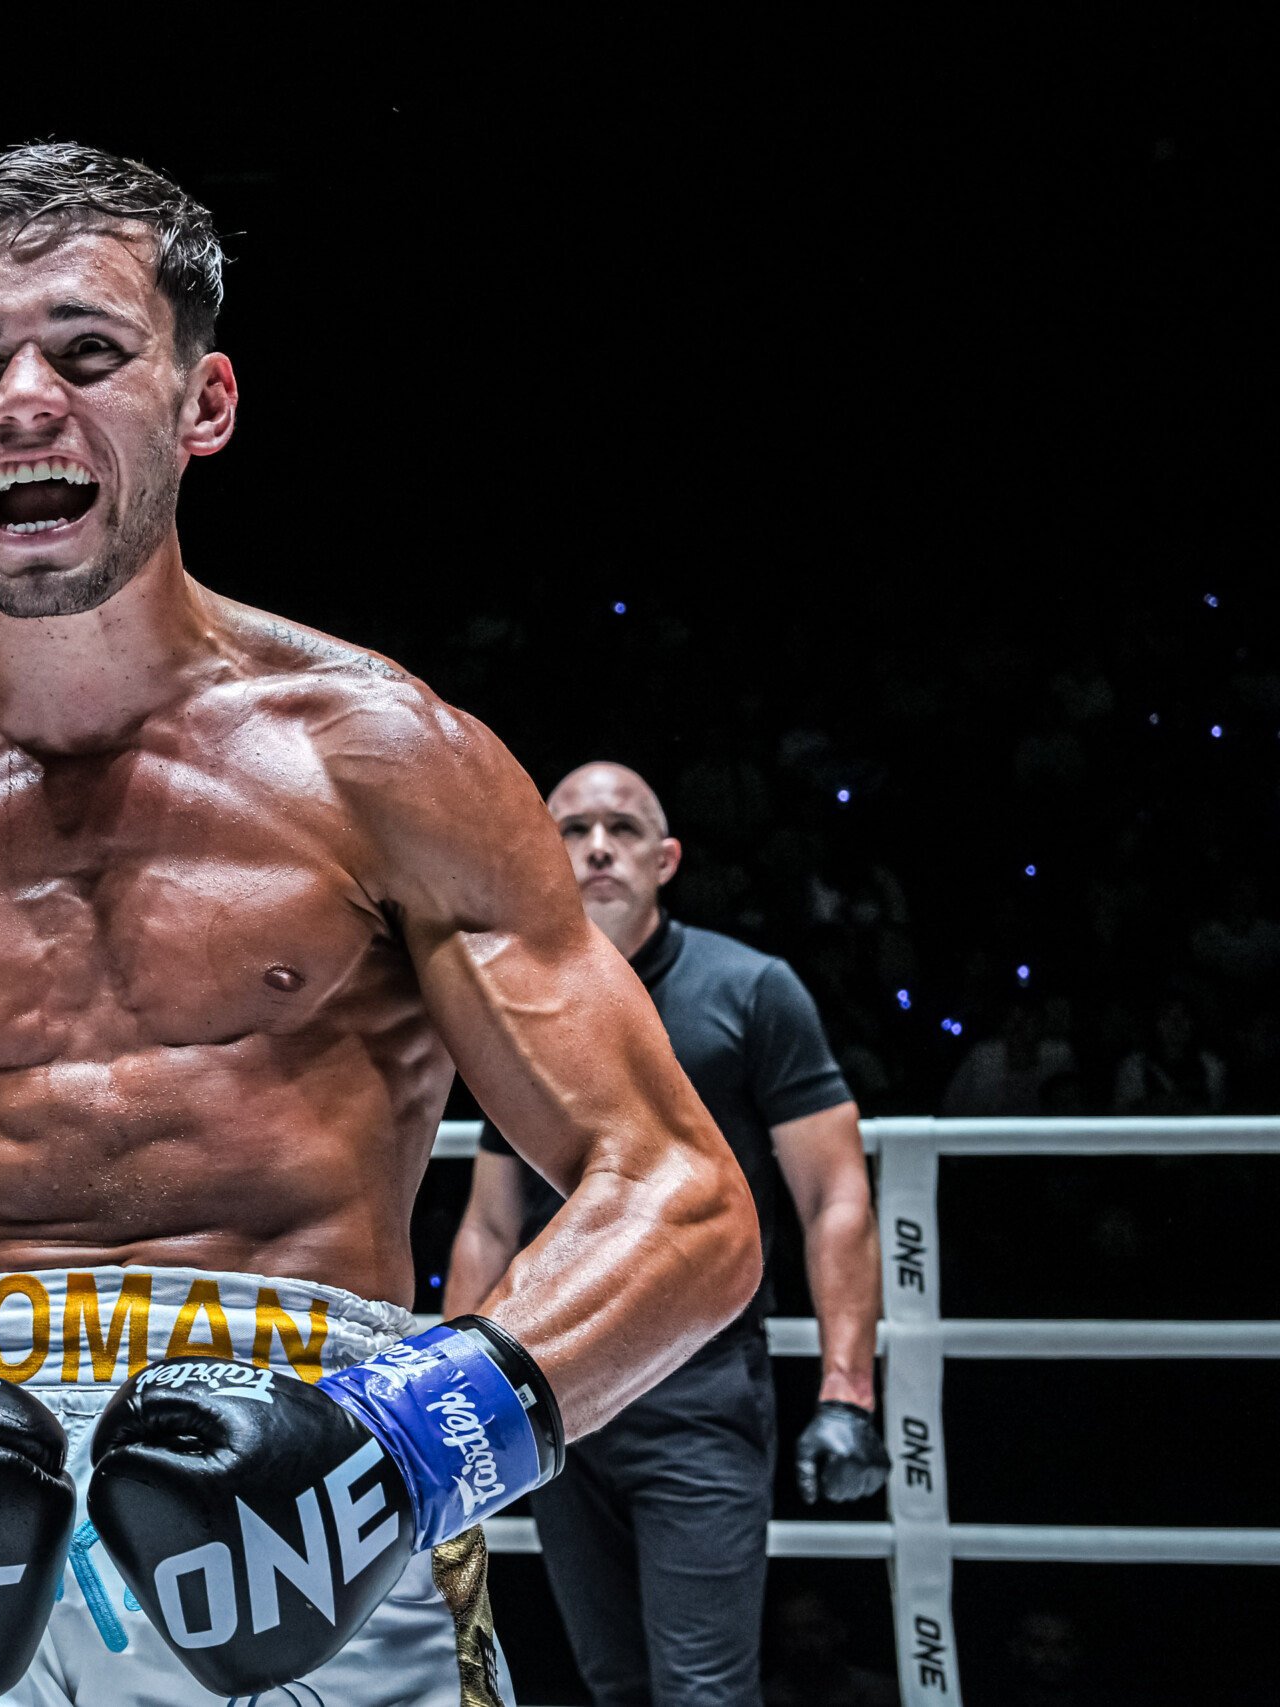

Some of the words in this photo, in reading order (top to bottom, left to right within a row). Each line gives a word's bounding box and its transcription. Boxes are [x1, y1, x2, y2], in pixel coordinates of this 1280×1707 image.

[892, 1217, 926, 1294] ONE
[136, 1363, 275, 1404] Fairtex
[426, 1391, 506, 1516] Fairtex
[900, 1416, 933, 1494] ONE
[154, 1437, 400, 1650] ONE
[912, 1615, 948, 1695] ONE
